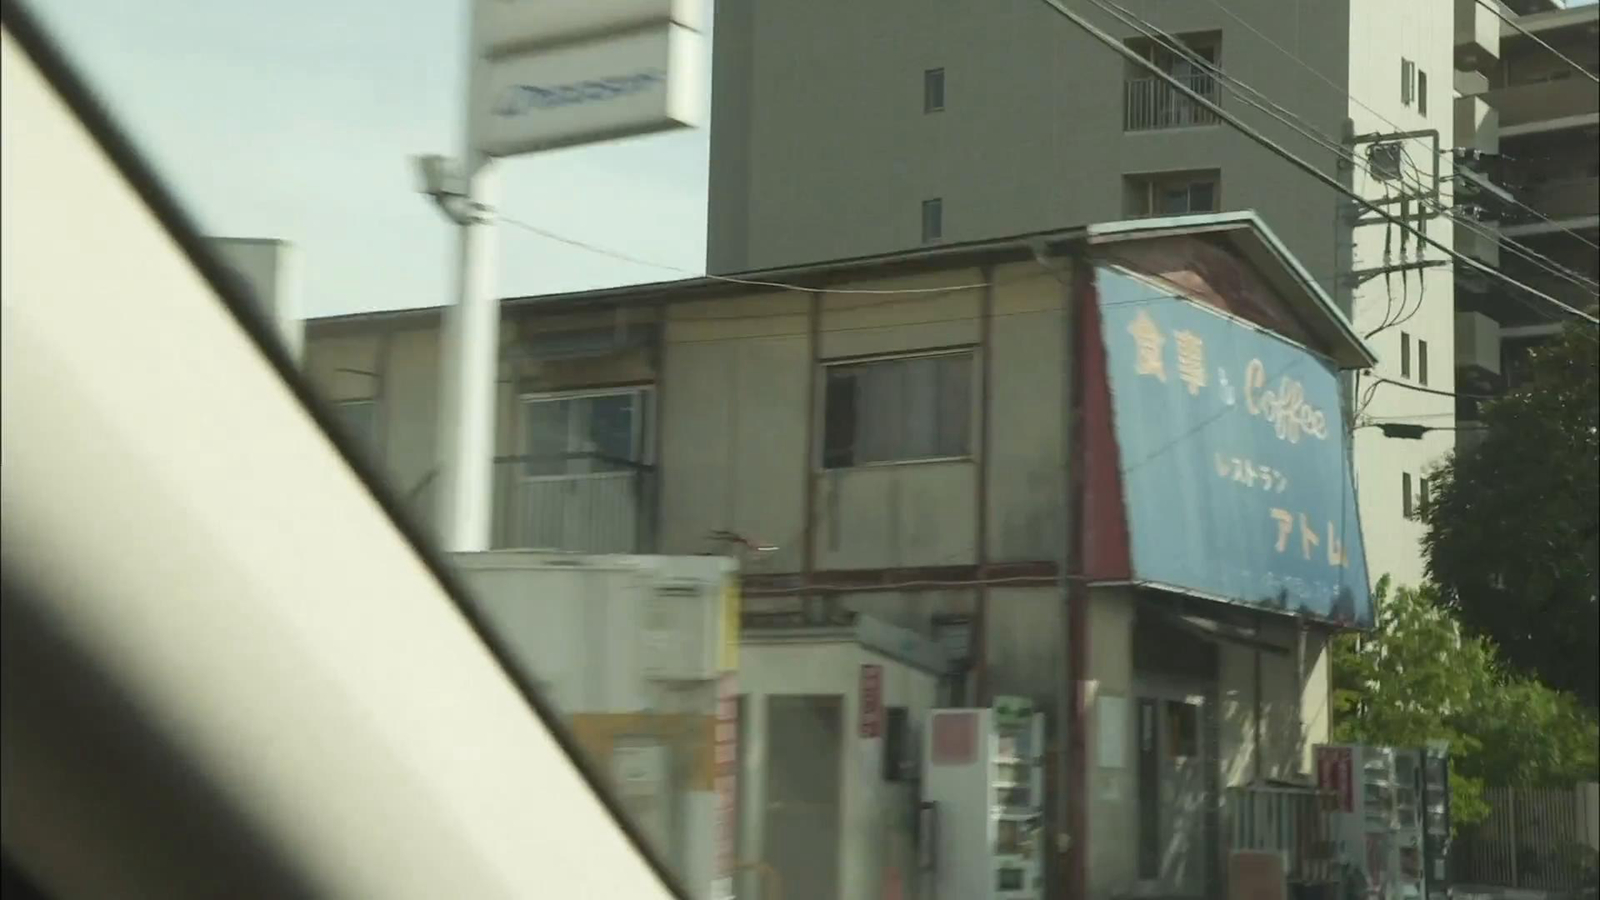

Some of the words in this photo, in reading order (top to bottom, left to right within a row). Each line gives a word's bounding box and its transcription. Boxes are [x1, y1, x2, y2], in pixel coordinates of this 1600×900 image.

[1128, 312, 1207, 396] 食事
[1246, 359, 1327, 443] Coffee
[1214, 454, 1286, 492] レストラン
[1270, 508, 1347, 566] アトム
